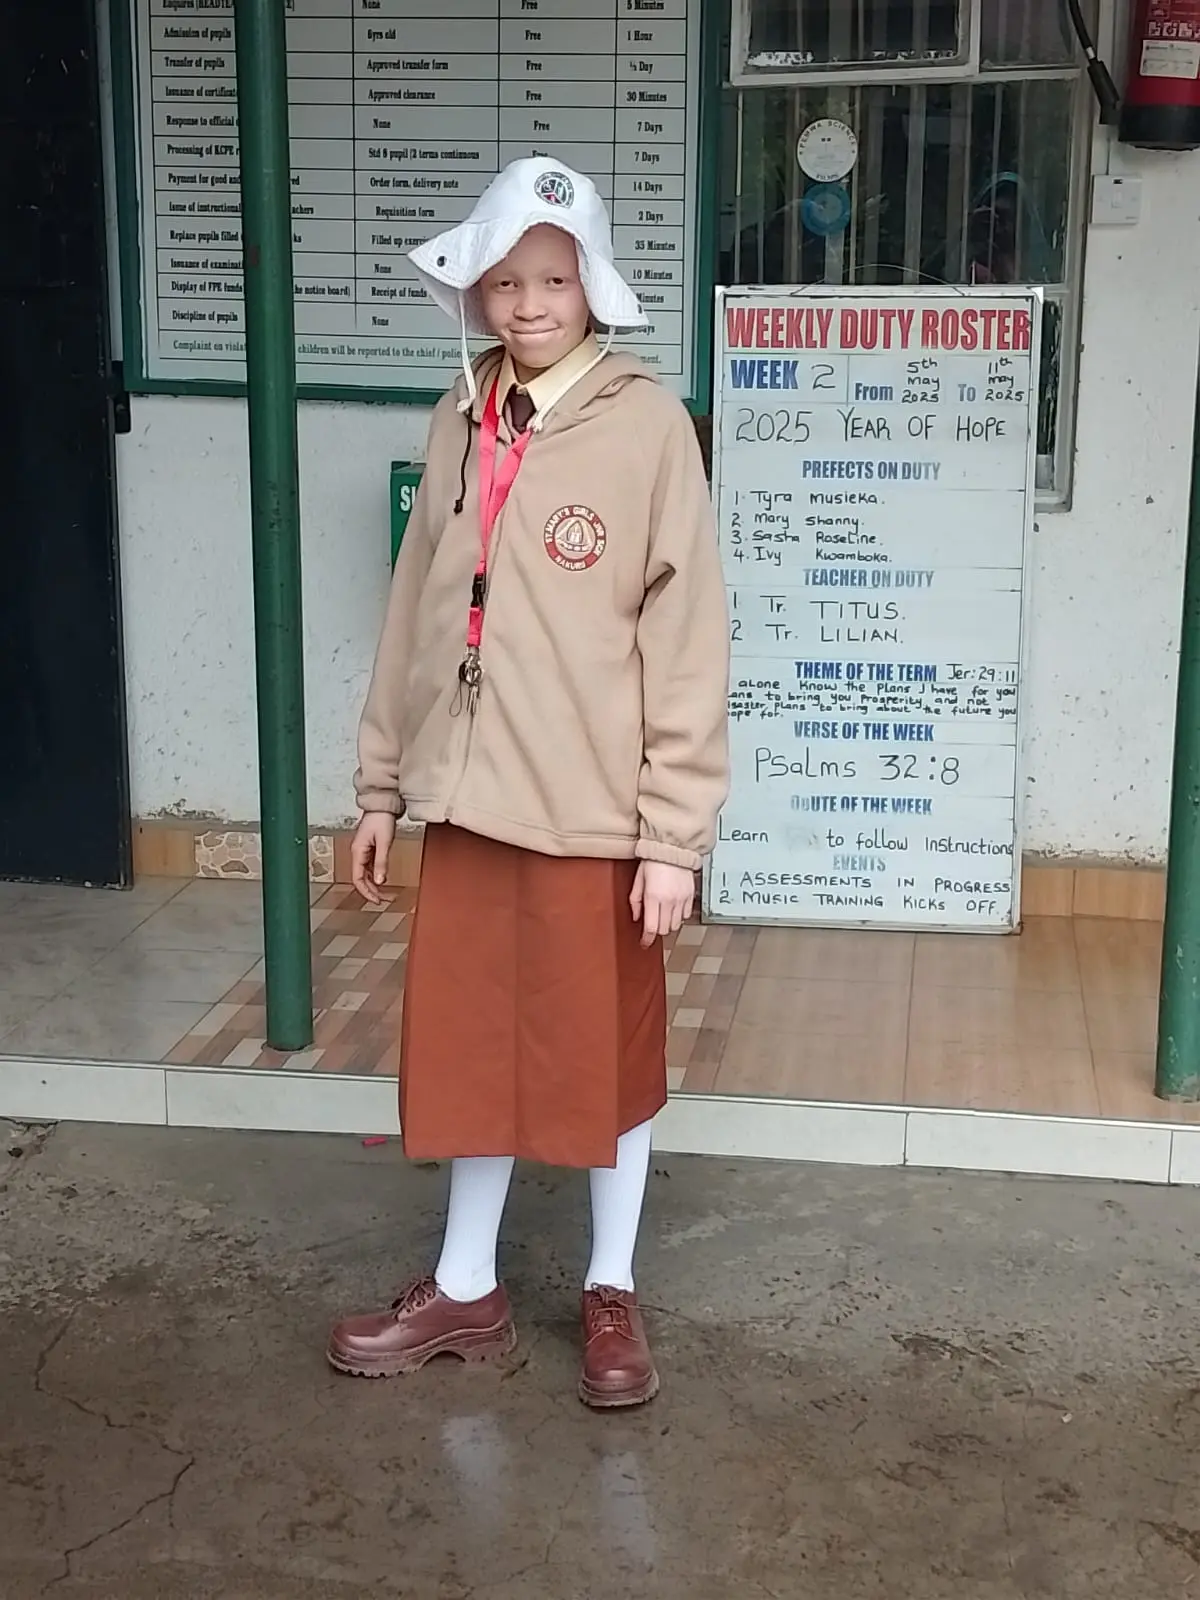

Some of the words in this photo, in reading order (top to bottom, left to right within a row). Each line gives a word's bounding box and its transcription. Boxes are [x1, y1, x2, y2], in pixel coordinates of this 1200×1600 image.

[163, 27, 200, 38] Admission
[202, 27, 208, 38] of
[210, 28, 231, 42] pupils
[385, 28, 396, 40] old
[525, 30, 541, 40] Free
[634, 31, 653, 40] Hour
[367, 59, 400, 72] Approved
[402, 59, 430, 70] transfer
[432, 59, 448, 70] form
[526, 60, 542, 71] Free
[639, 61, 654, 74] Day
[368, 89, 402, 102] Approved
[403, 89, 436, 100] clearance
[526, 90, 542, 101] Free
[626, 91, 637, 102] 30
[639, 92, 668, 102] Minutes
[373, 119, 391, 128] None
[533, 120, 550, 131] Free
[644, 122, 663, 134] Days
[641, 152, 660, 164] Days
[370, 178, 390, 188] Order
[413, 178, 442, 191] delivery
[443, 179, 458, 188] note
[633, 182, 642, 192] 14
[644, 182, 663, 194] Days
[376, 206, 416, 220] Requisition
[418, 207, 435, 217] form
[638, 212, 644, 221] 2
[645, 212, 664, 224] Days
[635, 240, 645, 250] 35
[647, 240, 676, 251] Minutes
[374, 264, 392, 273] None
[632, 270, 642, 280] 10
[644, 270, 673, 280] Minutes
[171, 281, 198, 294] Display
[200, 281, 207, 292] of
[371, 287, 397, 299] Receipt
[399, 287, 406, 297] of
[408, 287, 428, 298] funds
[172, 310, 206, 322] Discipline
[208, 311, 216, 321] of
[216, 311, 238, 324] pupils
[372, 316, 390, 326] None
[726, 308, 833, 349] WEEKLY
[839, 308, 915, 350] DUTY
[921, 309, 1031, 351] ROSTER
[906, 357, 938, 374] 5th
[988, 356, 1013, 374] 11th
[731, 359, 799, 390] WEEK
[811, 364, 837, 391] 2
[855, 382, 894, 401] From
[901, 390, 940, 404] 2025
[958, 384, 976, 401] To
[984, 388, 1024, 401] 2025
[736, 408, 813, 443] 2025
[836, 406, 892, 442] YEAR
[907, 414, 937, 440] OF
[956, 415, 1006, 442] HOPE
[802, 460, 874, 480] PREFECTS
[877, 461, 898, 480] ON
[901, 462, 942, 481] DUTY
[750, 490, 792, 511] Tyra
[754, 512, 790, 530] Mary
[752, 530, 800, 543] Sasha
[733, 548, 750, 564] 4.
[752, 546, 782, 566] Ivy
[803, 568, 867, 587] TEACHER
[871, 570, 891, 588] ON
[894, 570, 935, 588] DUTY
[760, 595, 787, 613] Tr.
[809, 600, 906, 620] TITUS.
[764, 624, 798, 641] Tr.
[820, 626, 904, 644] LILIAN.
[794, 661, 842, 680] THEME
[846, 662, 864, 680] OF
[866, 663, 894, 681] THE
[896, 664, 937, 682] TERM
[844, 680, 866, 692] the
[931, 684, 958, 696] have
[971, 685, 989, 698] for
[996, 688, 1016, 701] you
[728, 691, 752, 699] ans
[764, 690, 782, 701] to
[788, 692, 820, 706] bring
[830, 693, 852, 705] you
[934, 696, 958, 705] and
[967, 697, 990, 706] not
[728, 700, 766, 710] isaster
[820, 702, 832, 712] to
[840, 704, 868, 715] bring
[876, 704, 912, 713] about
[922, 704, 942, 715] the
[950, 706, 992, 716] future
[998, 708, 1017, 720] you
[728, 710, 752, 722] ope
[794, 720, 838, 740] VERSE
[842, 722, 860, 740] OF
[862, 722, 890, 740] THE
[893, 723, 935, 742] WEEK
[755, 746, 857, 783] Psalms
[878, 754, 960, 786] 32:8
[840, 796, 858, 812] OF
[861, 796, 888, 814] THE
[891, 798, 933, 816] WEEK
[718, 814, 769, 843] Learn
[826, 828, 844, 848] to
[856, 828, 908, 851] follow
[832, 854, 886, 872] EVENTS
[740, 871, 872, 888] ASSESSMENTS
[898, 878, 915, 888] IN
[934, 878, 1010, 894] PROGRESS
[742, 891, 800, 905] MUSIC
[812, 893, 884, 907] TRAINING
[904, 894, 946, 910] KICKS
